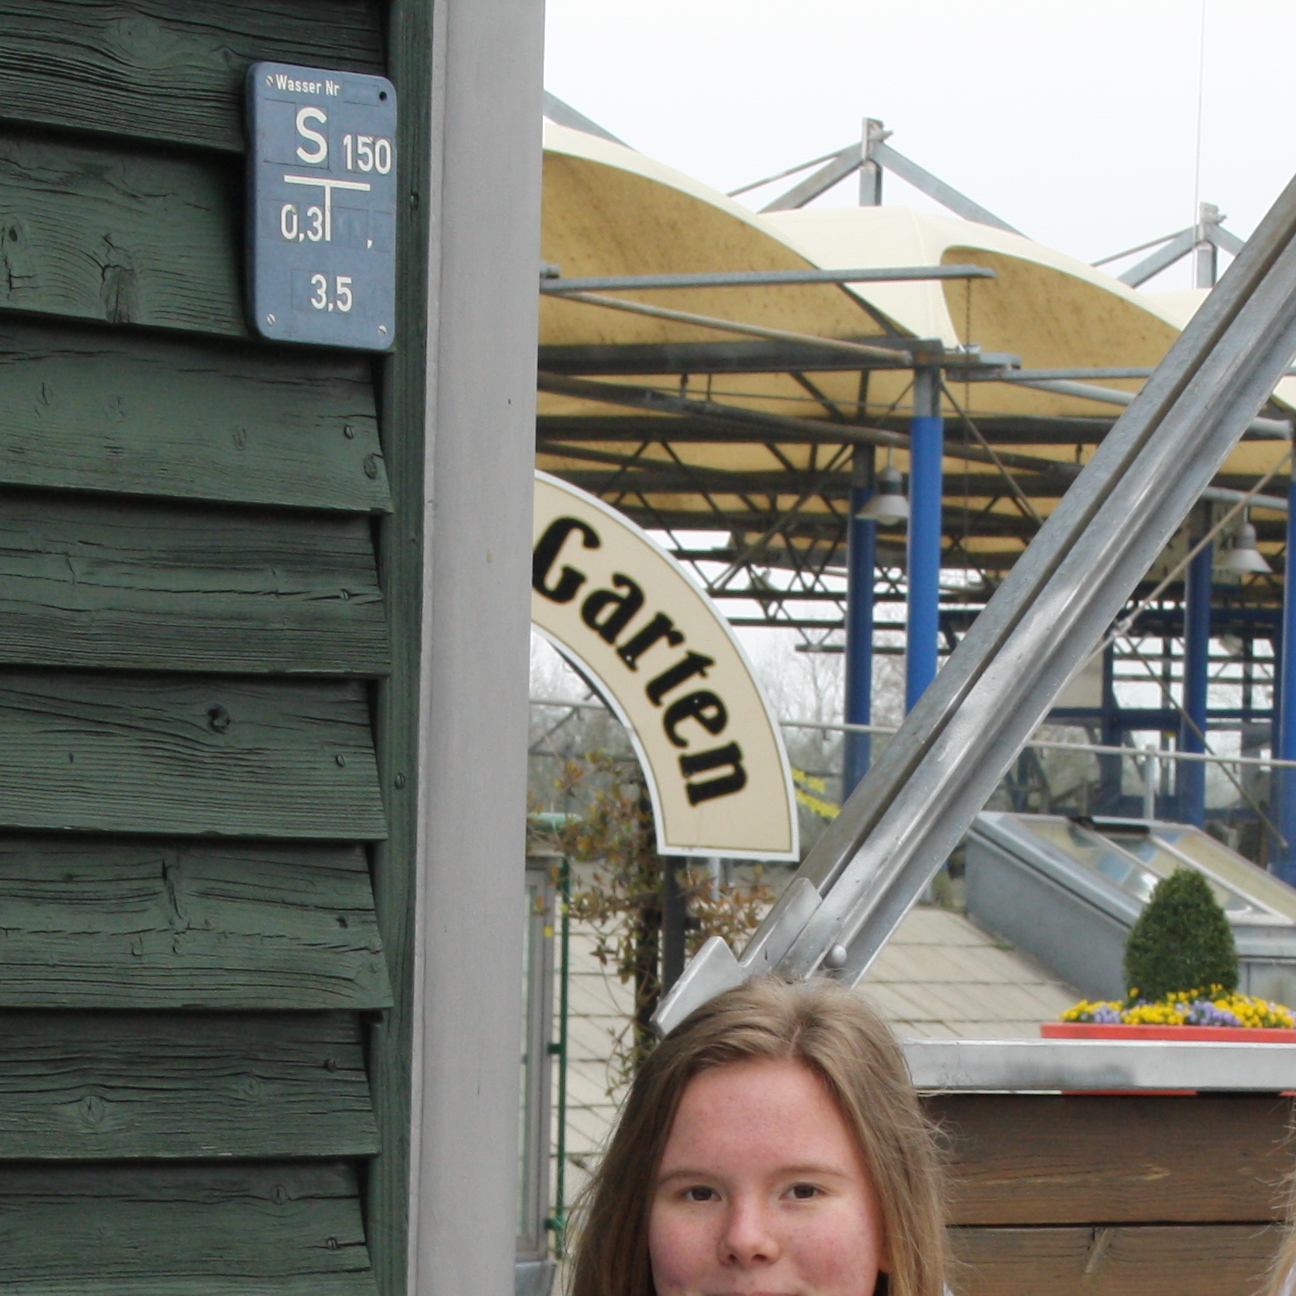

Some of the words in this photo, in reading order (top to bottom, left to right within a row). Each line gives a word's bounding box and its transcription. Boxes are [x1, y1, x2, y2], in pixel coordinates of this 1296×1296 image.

[275, 73, 322, 95] Wasser
[325, 79, 340, 97] Nr
[295, 106, 328, 164] S
[342, 134, 392, 175] 150
[310, 273, 353, 313] 3,5
[532, 516, 748, 807] Garten
